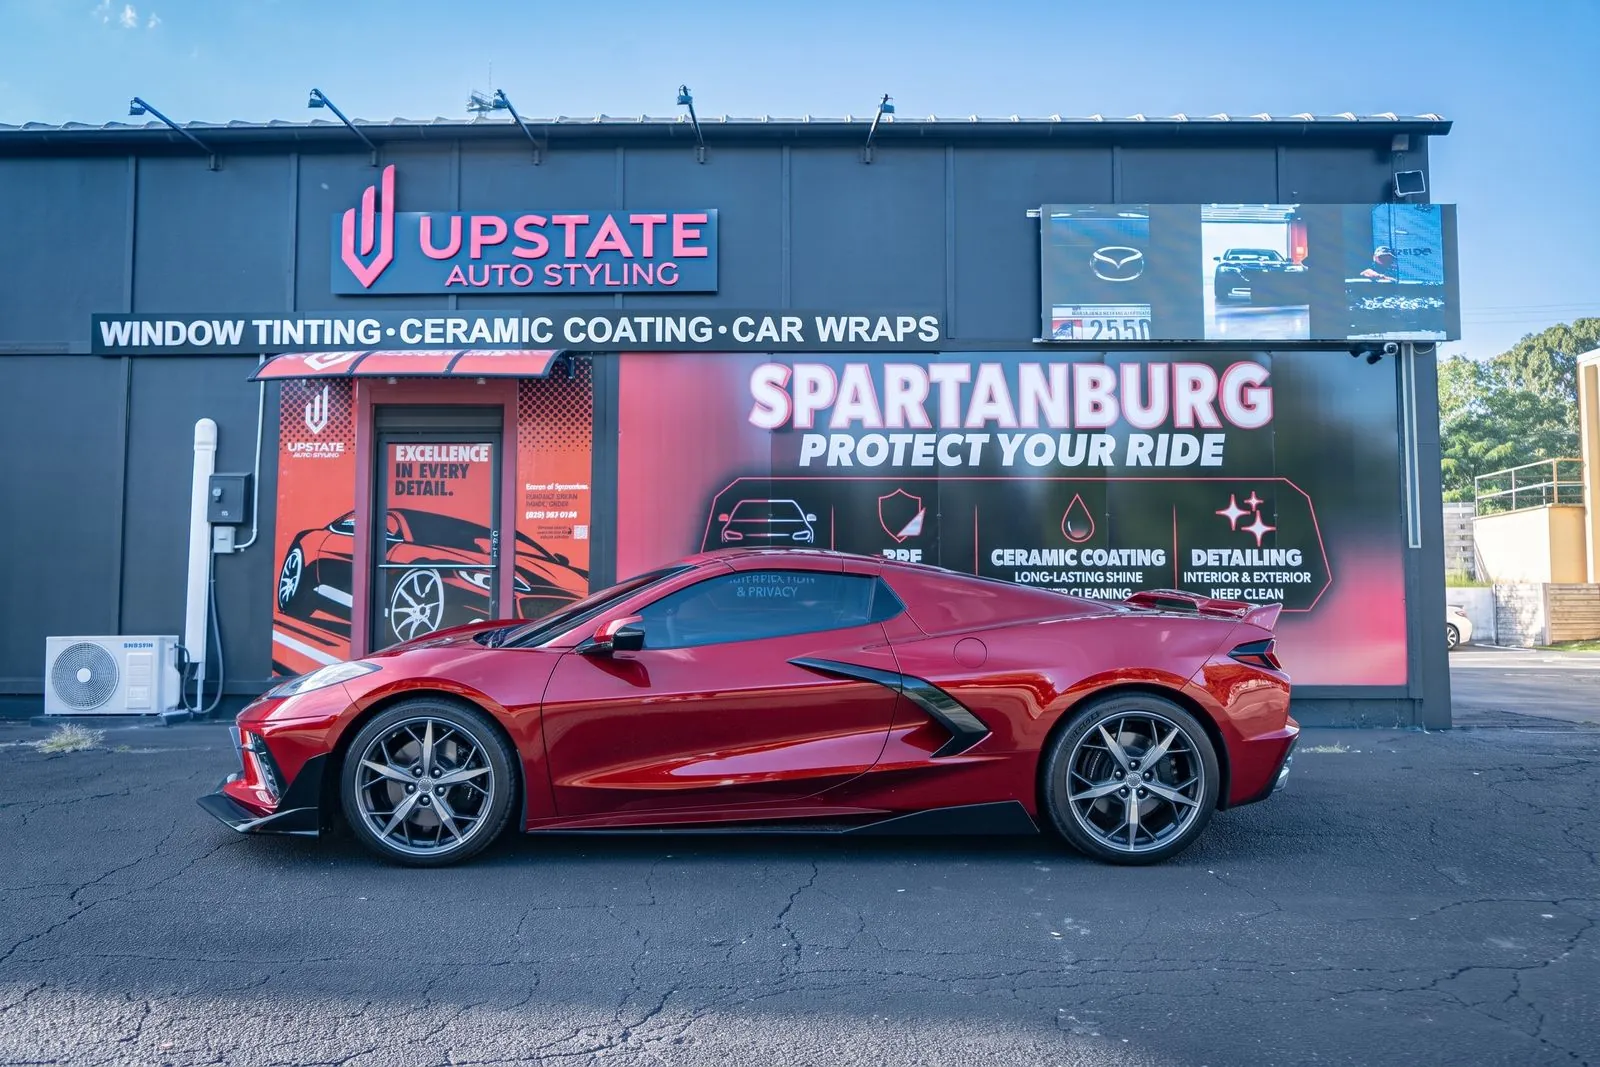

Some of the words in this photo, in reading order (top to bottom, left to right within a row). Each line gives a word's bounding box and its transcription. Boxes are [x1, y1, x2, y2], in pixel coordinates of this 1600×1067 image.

[419, 213, 708, 260] UPSTATE
[445, 263, 534, 287] AUTO
[543, 262, 680, 287] STYLING
[100, 320, 245, 347] WINDOW
[251, 318, 381, 345] TINTING
[399, 317, 554, 344] CERAMIC
[563, 316, 713, 343] COATING
[732, 316, 805, 343] CAR
[815, 315, 940, 343] WRAPS
[748, 360, 1274, 430] SPARTANBURG
[287, 442, 345, 452] UPSTATE
[395, 445, 489, 462] EXCELLENCE
[799, 433, 990, 467] PROTECT
[996, 433, 1117, 467] YOUR
[1125, 433, 1226, 467] RIDE
[395, 463, 413, 478] IN
[420, 463, 470, 479] EVERY
[394, 480, 454, 497] DETAIL.
[991, 549, 1078, 567] CERAMIC
[1080, 549, 1166, 567] COATING
[1191, 548, 1303, 567] DETAILING
[1014, 571, 1105, 583] LONG-LASTING
[1106, 571, 1144, 583] SHINE
[1183, 571, 1239, 583] INTERIOR
[1241, 571, 1251, 583] &
[1253, 571, 1312, 583] EXTERIOR
[736, 586, 746, 598] &
[748, 586, 798, 598] PRIVACY
[1070, 588, 1133, 600] CLEANING
[1243, 588, 1285, 600] CLEAN
